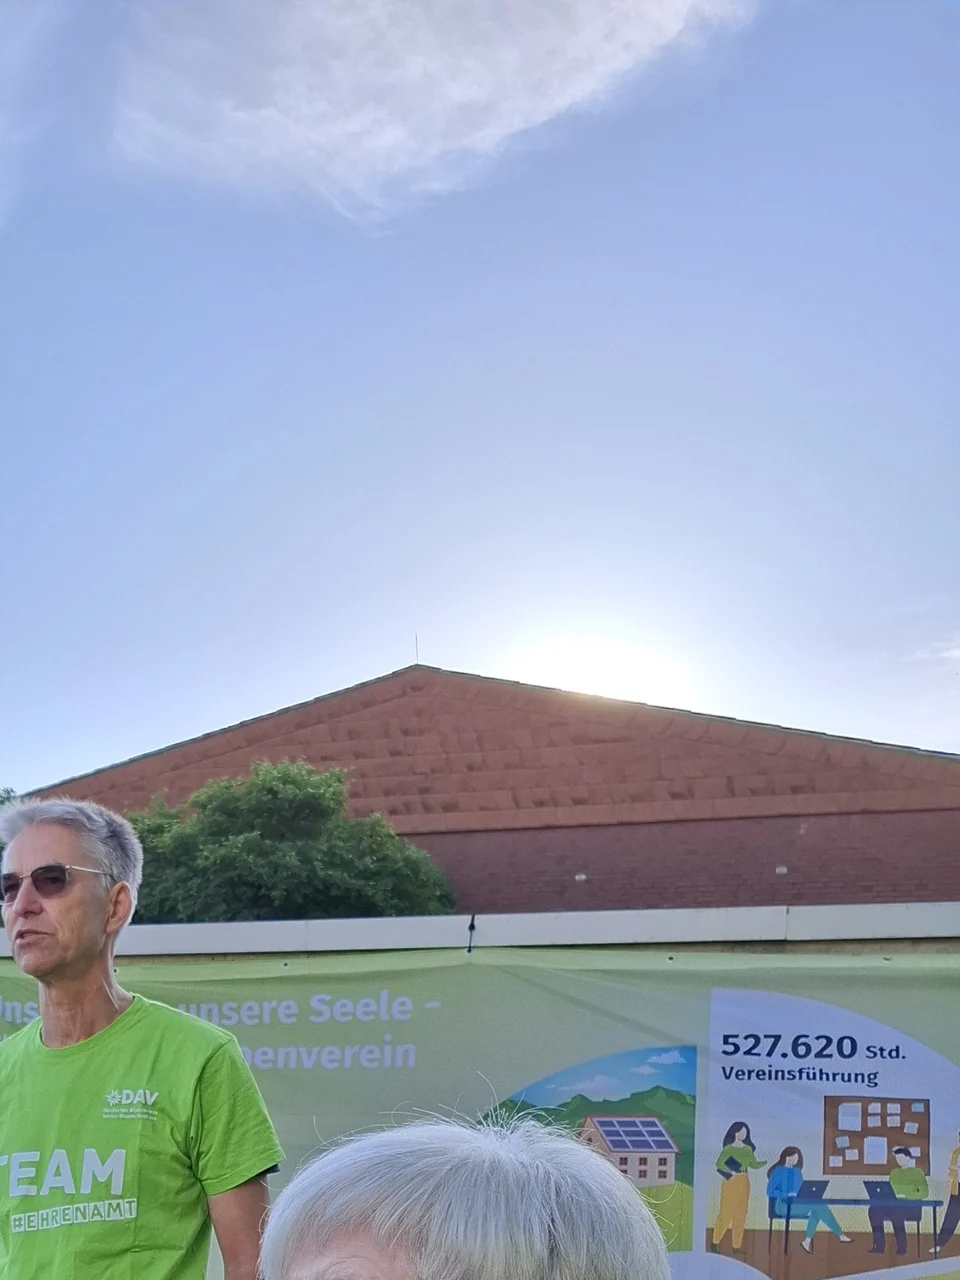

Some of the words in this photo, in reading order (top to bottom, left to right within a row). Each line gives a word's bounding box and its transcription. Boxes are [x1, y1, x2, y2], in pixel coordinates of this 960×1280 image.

[309, 989, 414, 1024] Seele
[721, 1034, 858, 1060] 527.620
[865, 1045, 906, 1060] Std.
[721, 1065, 879, 1088] Vereinsführung
[121, 1089, 159, 1106] DAV
[11, 1199, 136, 1232] #EHRENAMT
